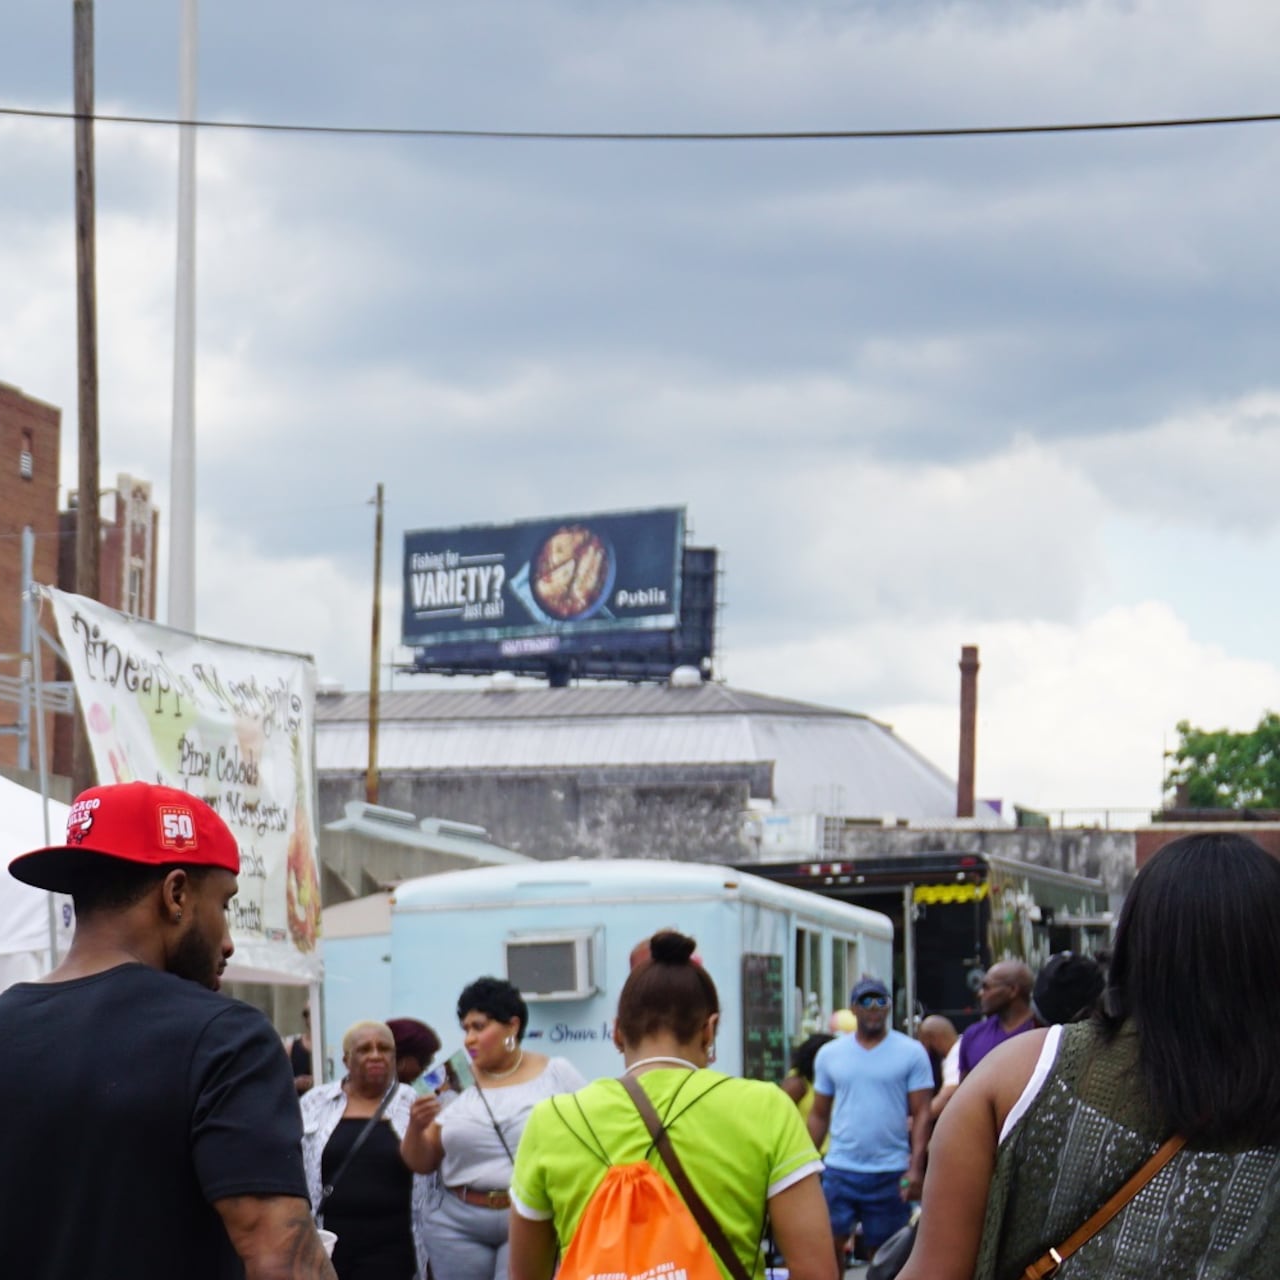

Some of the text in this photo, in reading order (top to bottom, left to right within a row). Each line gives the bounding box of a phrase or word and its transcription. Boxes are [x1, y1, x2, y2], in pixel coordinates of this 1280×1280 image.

[413, 552, 444, 571] Fishing
[412, 564, 505, 608] VARIETY?
[616, 588, 666, 607] Publix
[464, 599, 505, 620] Just ask!
[163, 814, 193, 838] 50
[551, 1023, 597, 1044] Shave
